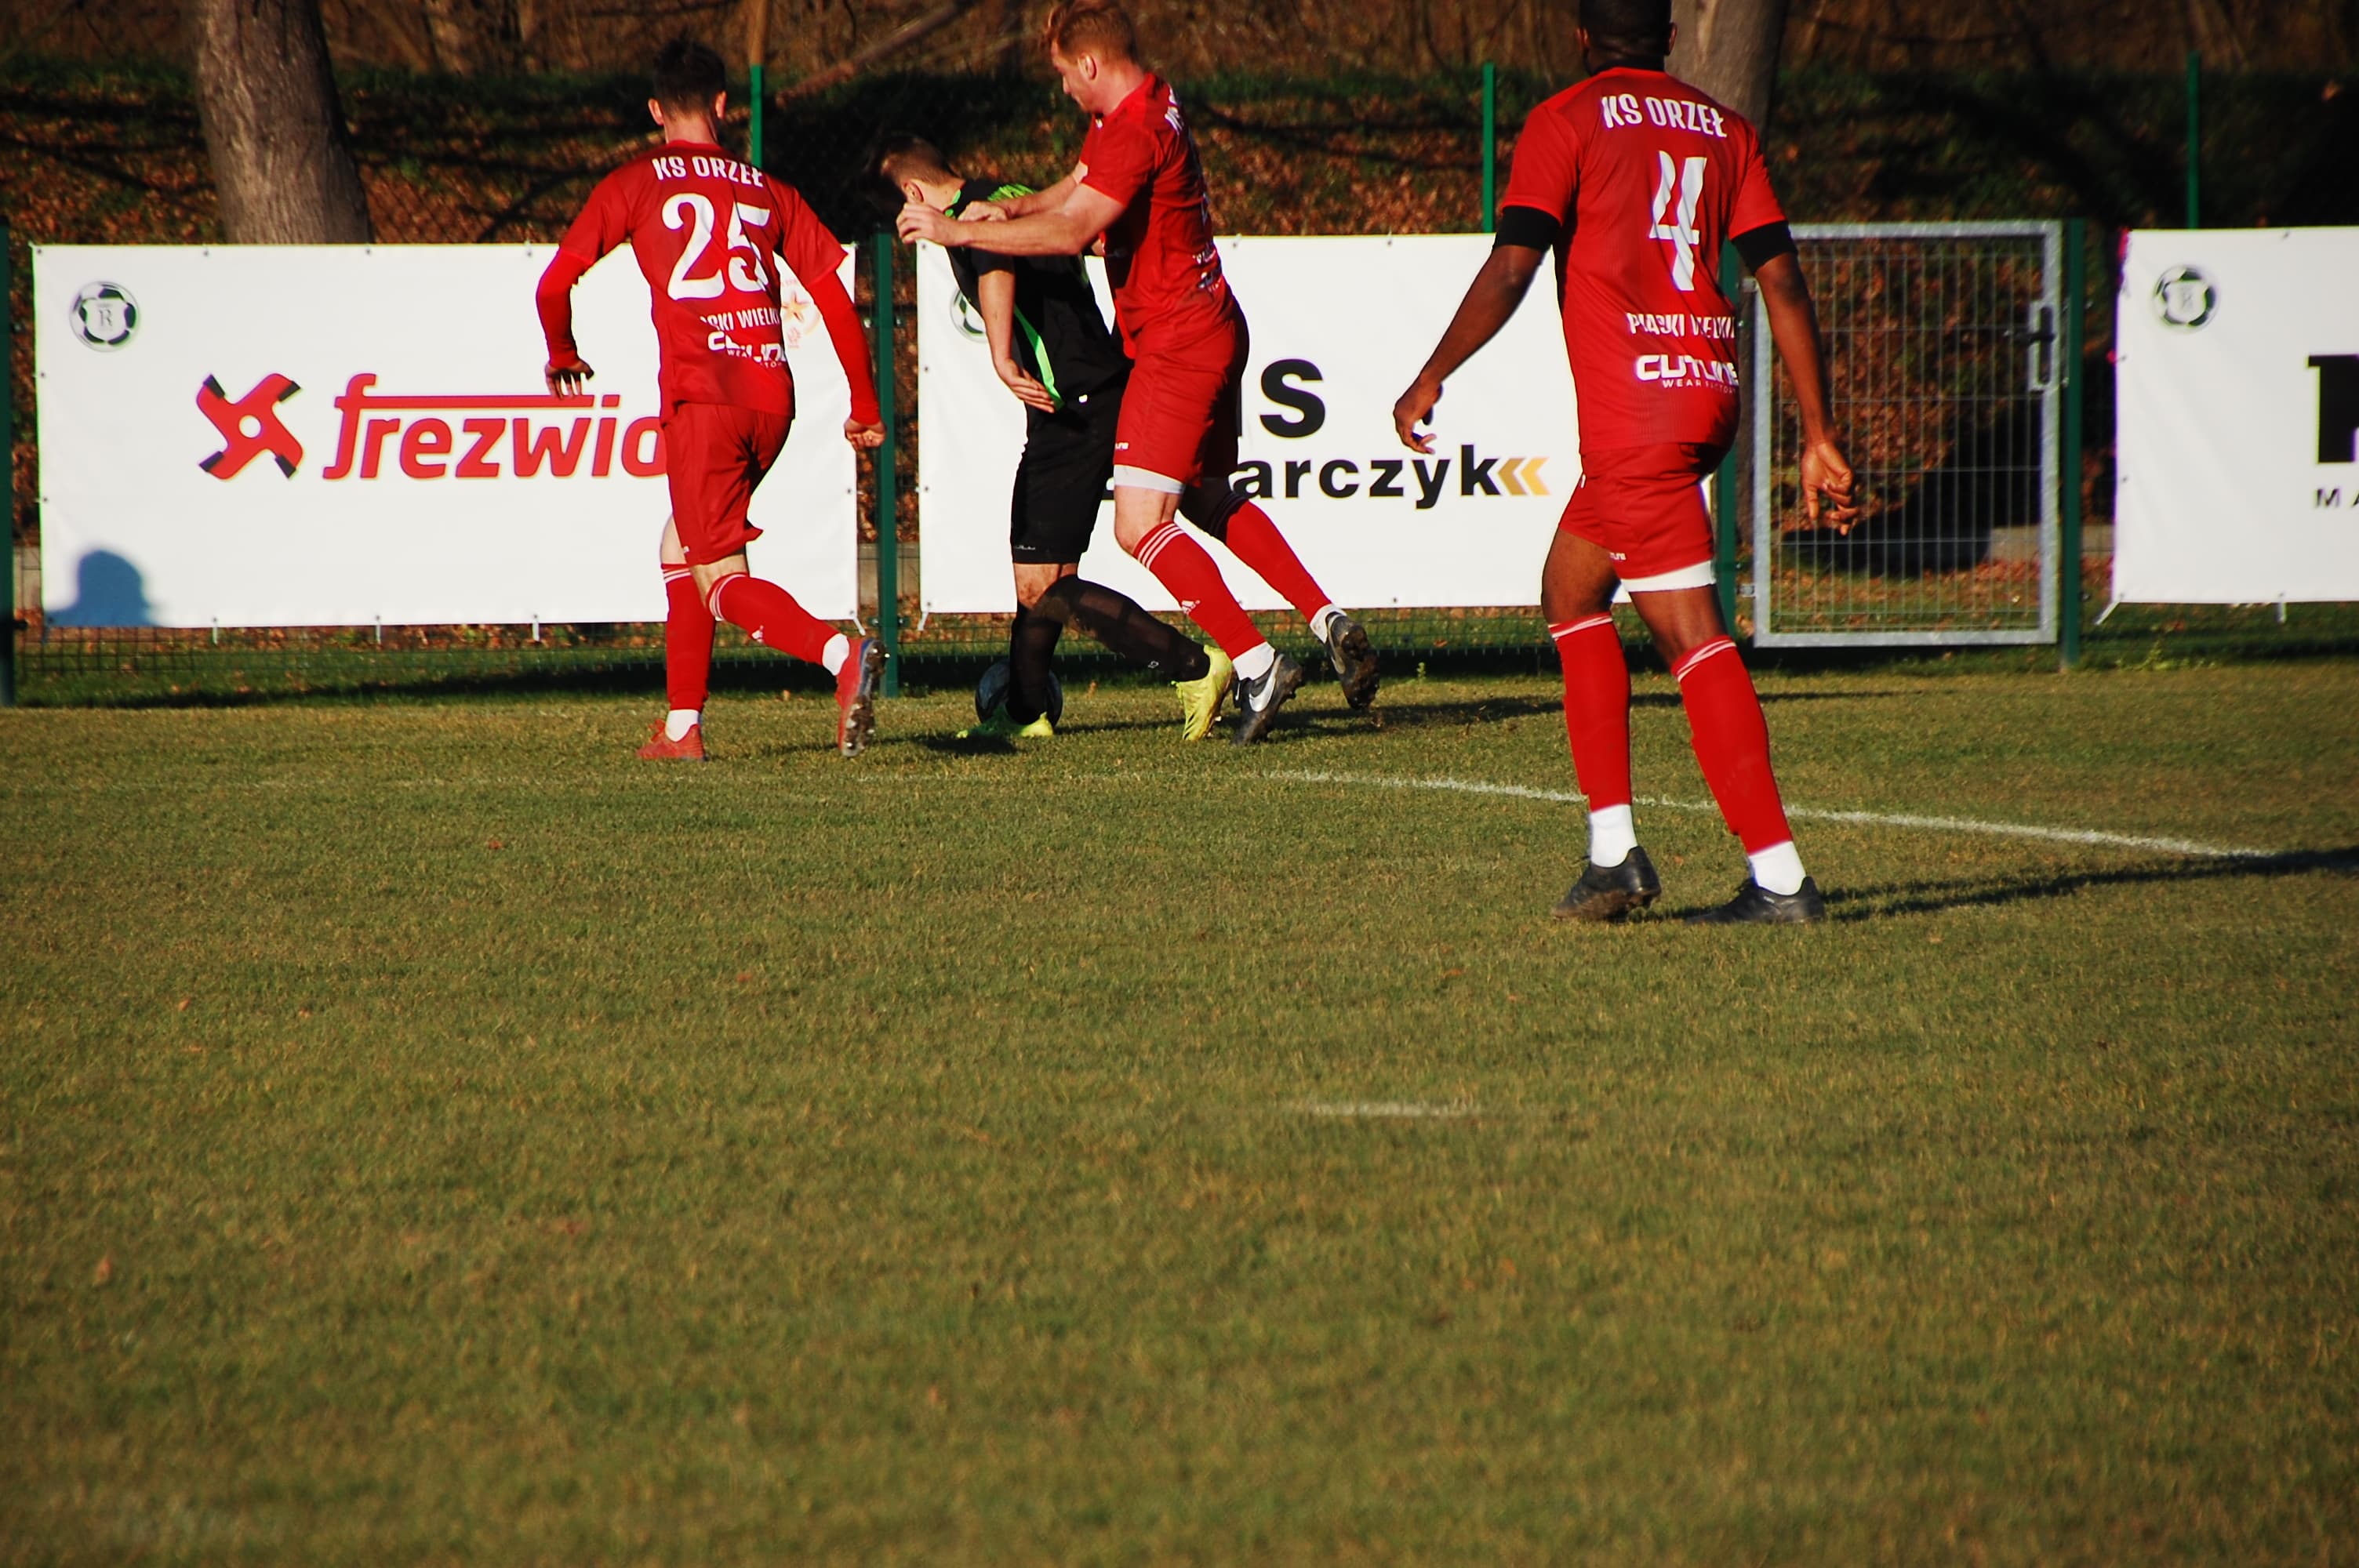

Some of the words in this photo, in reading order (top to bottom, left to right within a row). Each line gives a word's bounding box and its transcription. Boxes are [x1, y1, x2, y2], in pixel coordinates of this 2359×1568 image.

[1601, 93, 1643, 129] KS
[1645, 96, 1727, 138] ORZEŁ
[652, 157, 686, 180] KS
[662, 193, 770, 300] 25
[1649, 151, 1707, 291] 4
[1237, 358, 1326, 438] S
[1663, 379, 1701, 389] WEAR
[1232, 444, 1502, 510] arczyk
